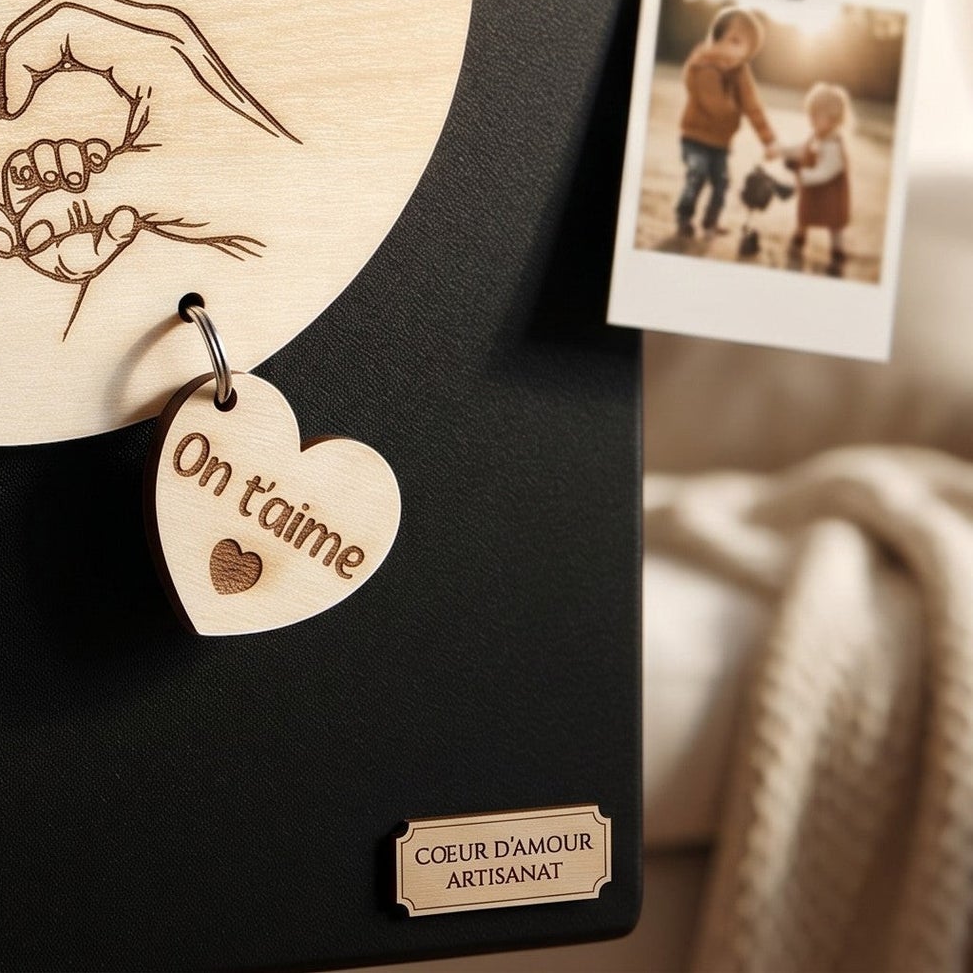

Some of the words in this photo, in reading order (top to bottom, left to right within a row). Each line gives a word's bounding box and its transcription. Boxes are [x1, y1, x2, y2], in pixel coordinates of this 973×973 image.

[173, 432, 233, 497] On
[238, 475, 366, 580] t'aime
[495, 832, 594, 858] D'AMOUR
[445, 862, 563, 890] ARTISANAT
